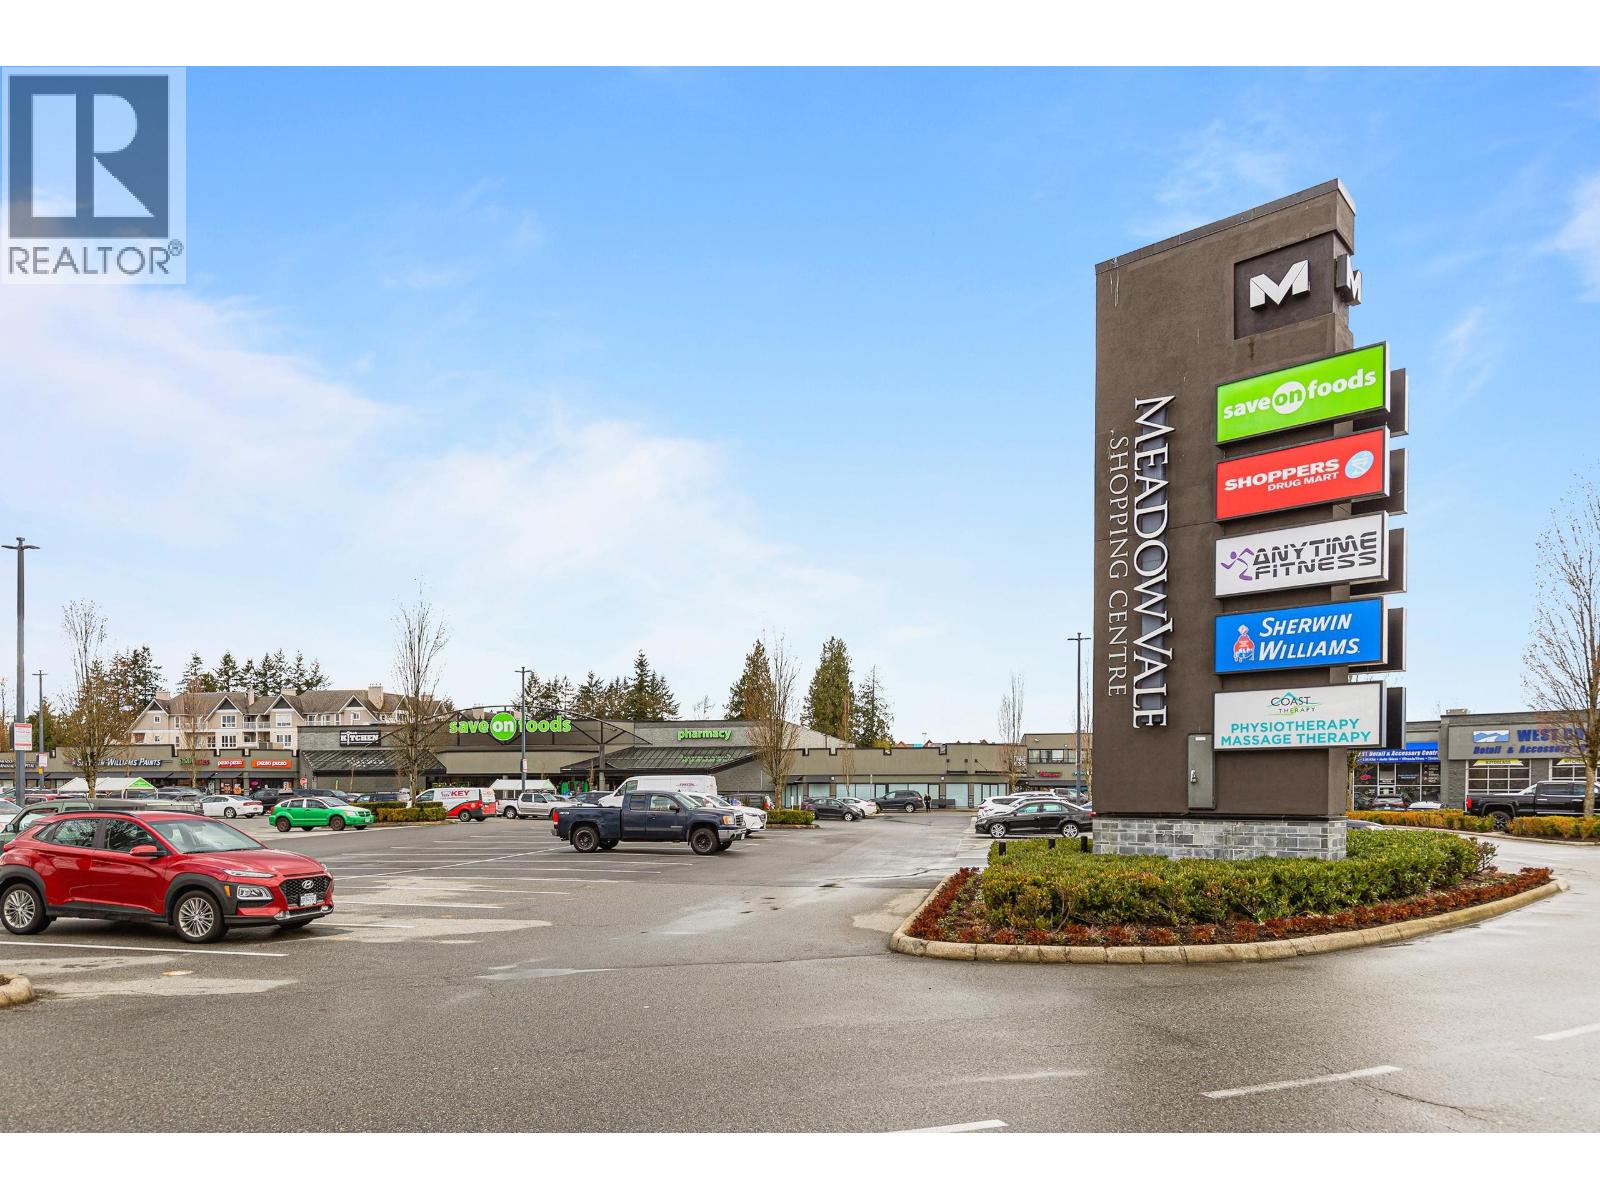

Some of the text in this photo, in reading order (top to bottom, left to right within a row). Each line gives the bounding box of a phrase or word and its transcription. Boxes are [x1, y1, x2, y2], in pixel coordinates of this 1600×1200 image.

[1249, 259, 1311, 310] M
[1224, 458, 1340, 491] SHOPPERS
[1267, 471, 1339, 492] DRUG MART
[1252, 531, 1377, 566] ANYTIME
[1108, 434, 1129, 697] SHOPPING CENTRE
[1133, 394, 1177, 729] MEADOWVALE
[1255, 550, 1377, 580] FITNESS
[1259, 613, 1353, 637] SHERWIN
[1258, 638, 1361, 662] WILLIAMS
[1270, 695, 1311, 707] COAST
[1278, 706, 1316, 715] THERAPY
[677, 728, 732, 741] pharmacy
[1220, 730, 1371, 746] MASSAGE THERAPY
[1230, 718, 1360, 734] PHYSIOTHERAPY
[1516, 728, 1558, 742] WEST
